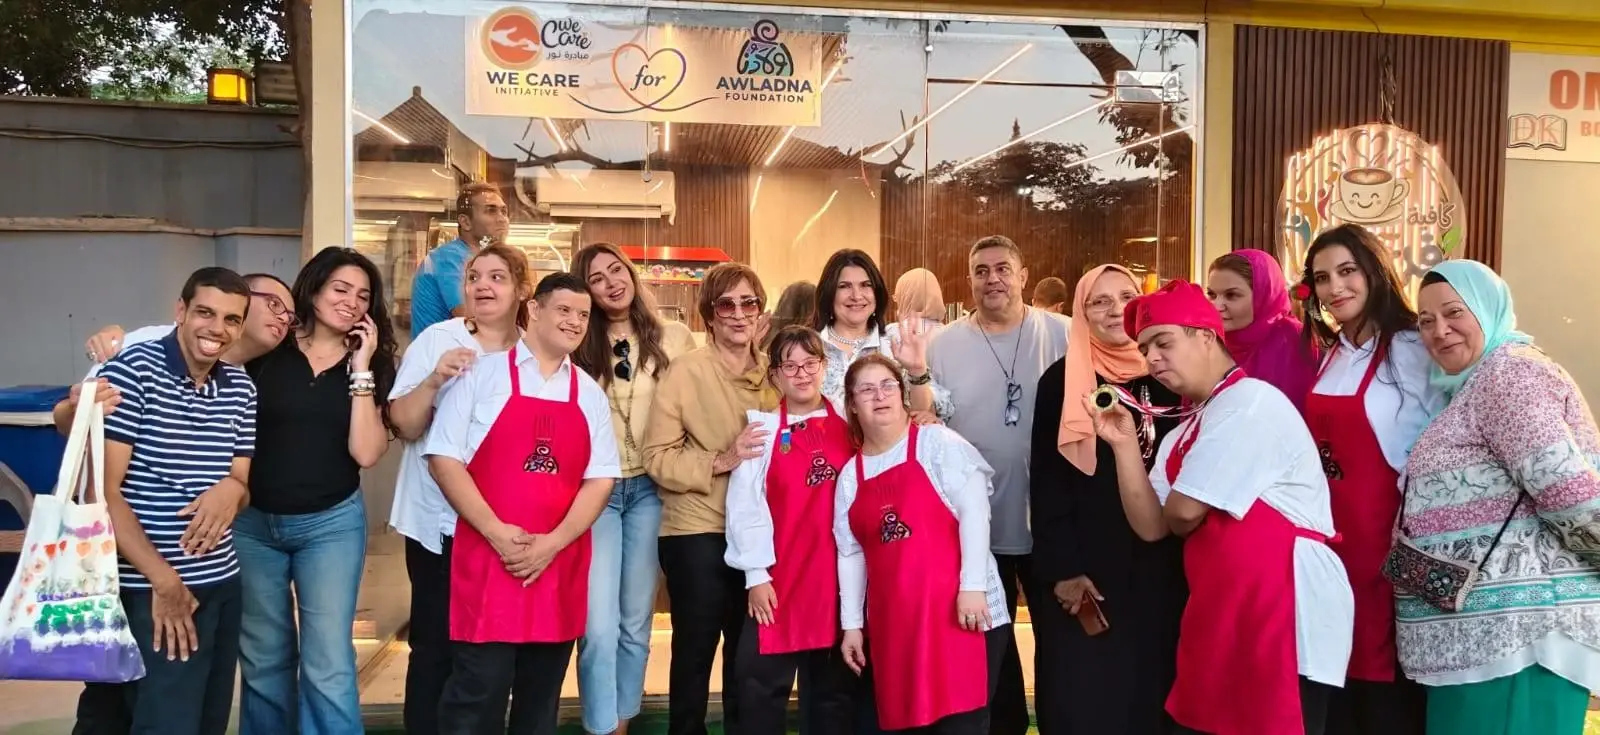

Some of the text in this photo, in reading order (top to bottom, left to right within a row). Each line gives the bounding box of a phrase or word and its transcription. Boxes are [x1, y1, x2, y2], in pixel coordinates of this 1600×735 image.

[545, 51, 590, 61] مبادرة نور
[486, 71, 580, 88] WE CARE
[630, 64, 666, 91] for
[716, 76, 813, 93] AWLADNA
[495, 86, 560, 97] INITIATIVE
[725, 92, 804, 103] FOUNDATION
[1512, 115, 1562, 145] DK
